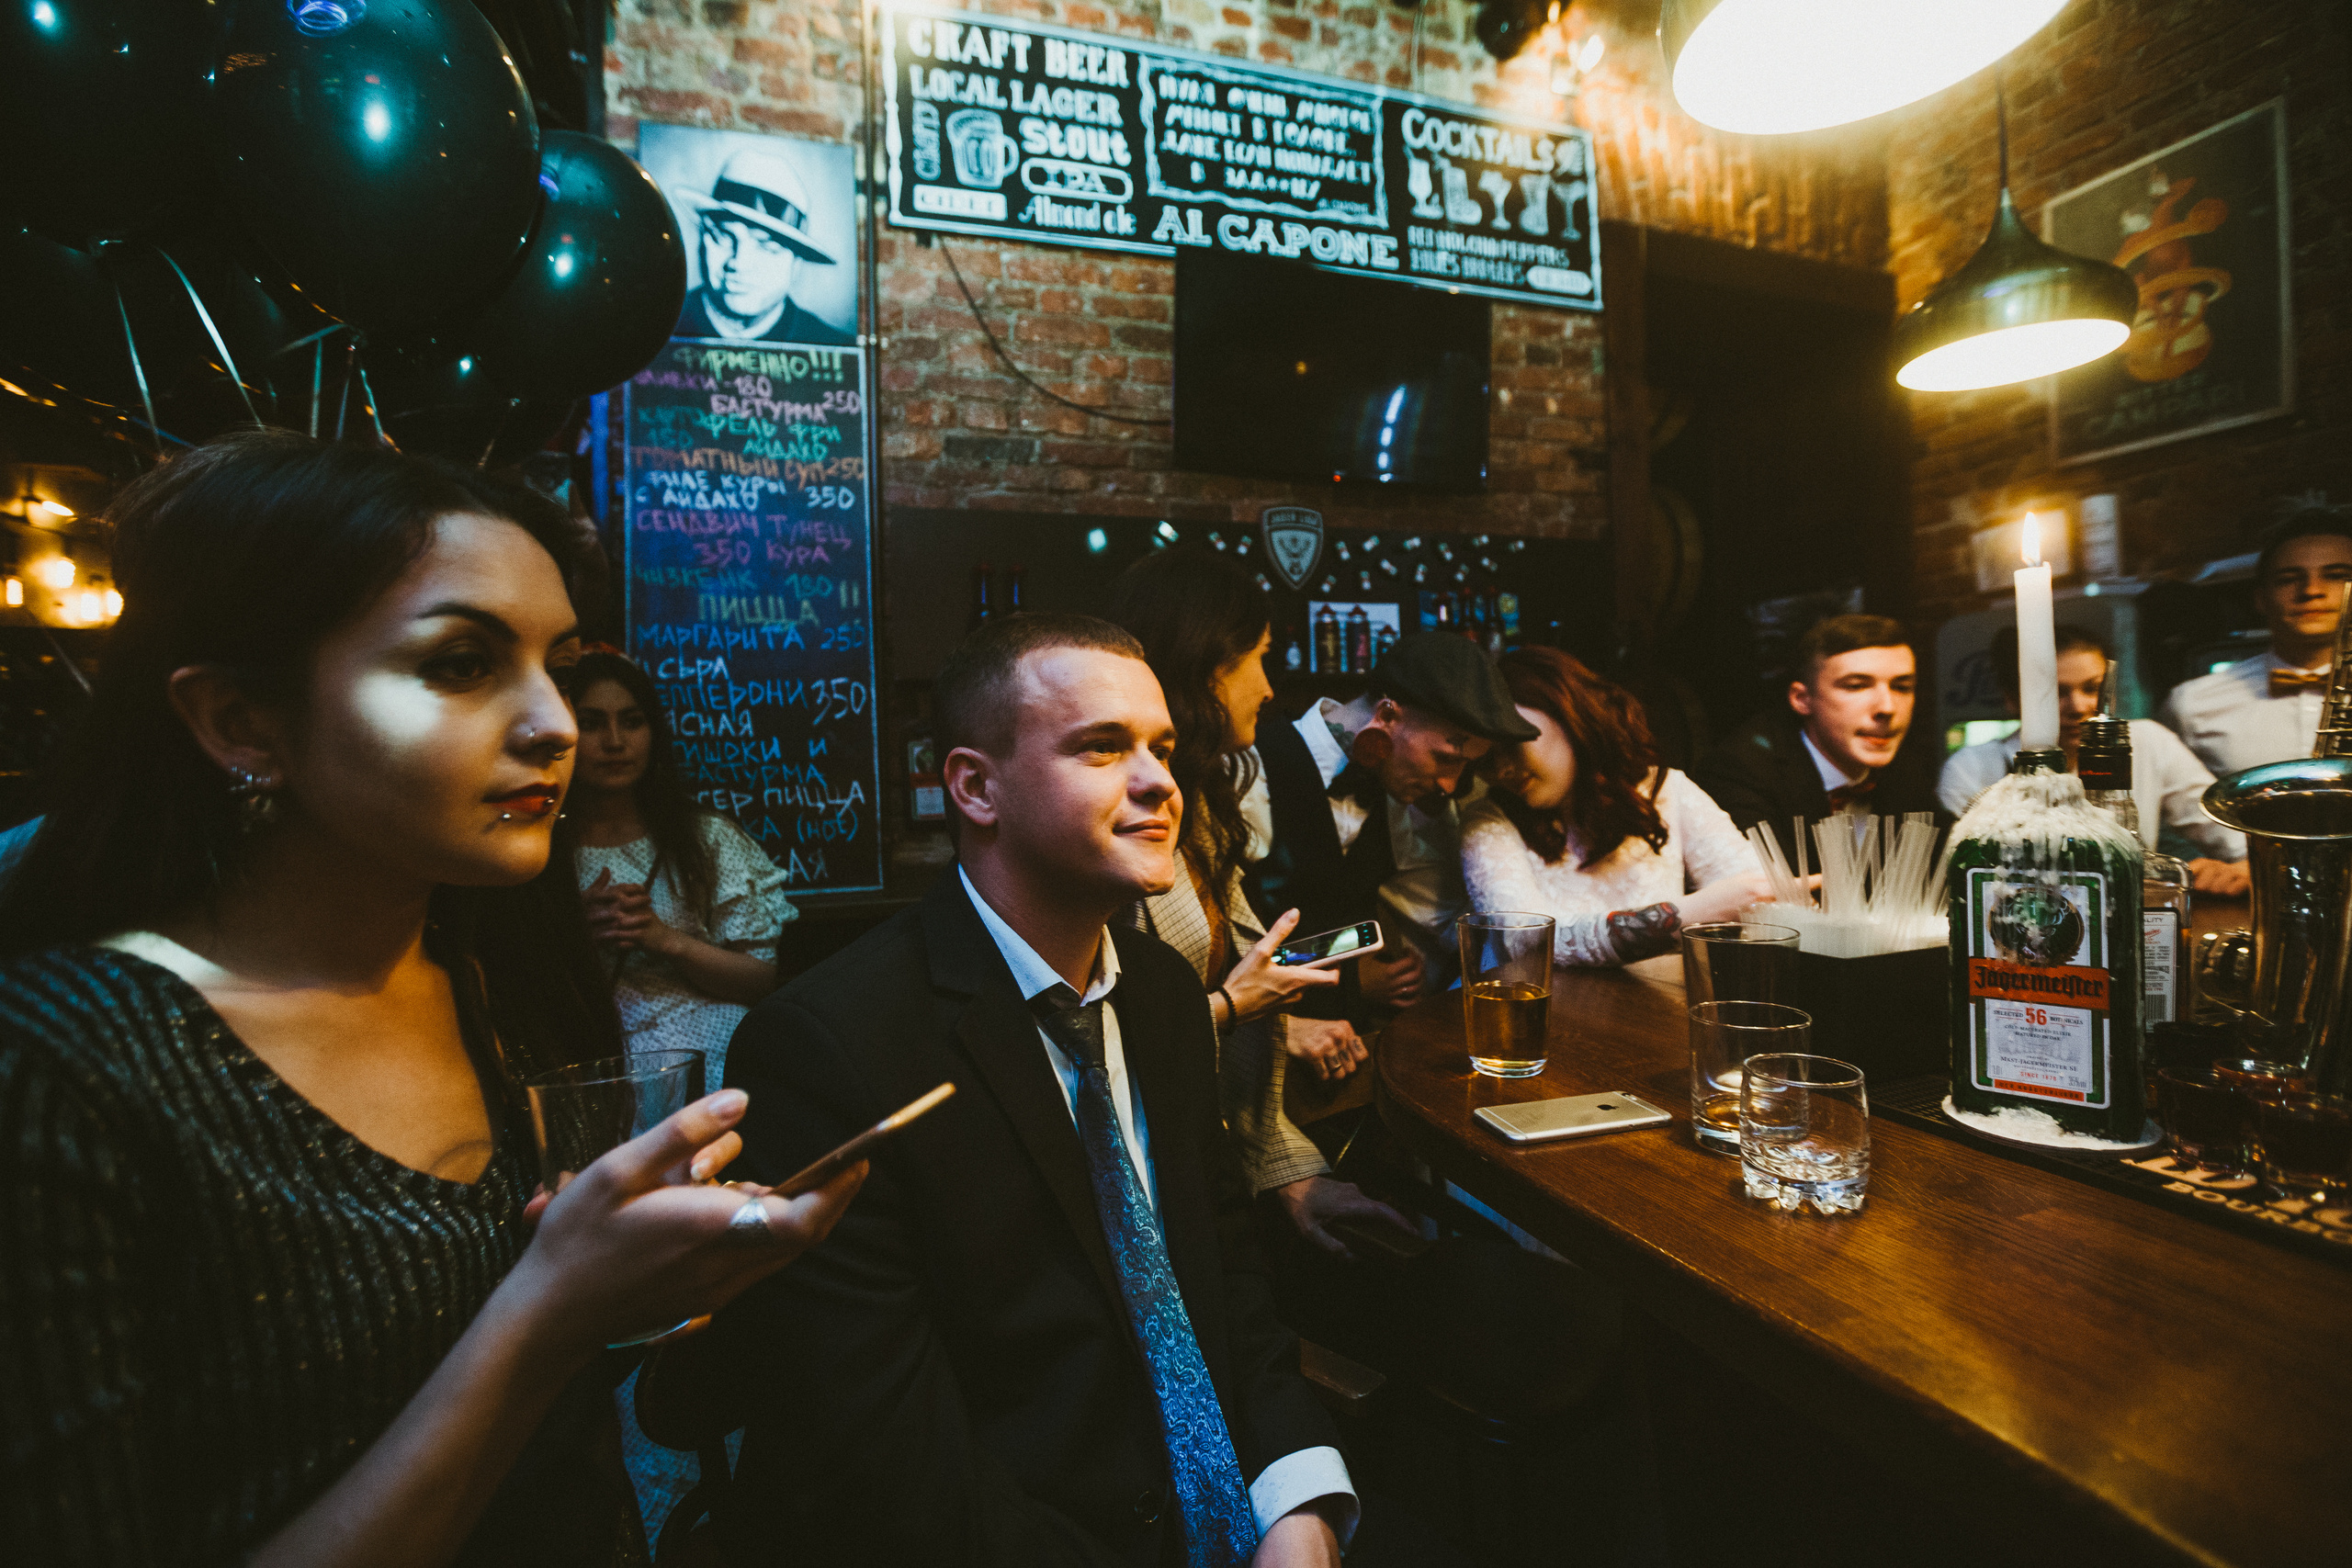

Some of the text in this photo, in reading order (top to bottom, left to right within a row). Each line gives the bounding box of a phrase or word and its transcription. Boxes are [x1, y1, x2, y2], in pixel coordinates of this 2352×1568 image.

[908, 19, 1130, 88] CRAFT BEER
[910, 64, 1124, 128] LOCAL LAGER
[1402, 107, 1555, 173] COCKTAILS
[1044, 166, 1111, 195] IPA
[1217, 213, 1399, 270] CAPONE
[710, 390, 862, 425] БАСТУРМА 250
[805, 486, 855, 510] 350
[766, 513, 853, 550] ТУНЕЦ
[693, 538, 831, 569] 350 КУРА
[636, 623, 865, 660] МАРГАРИТА 250
[657, 656, 730, 685] СЫРА
[655, 677, 866, 726] ЕППЕРОНИ 350
[808, 738, 827, 758] И
[2025, 1007, 2047, 1025] 56
[2020, 1071, 2039, 1079] SINCE
